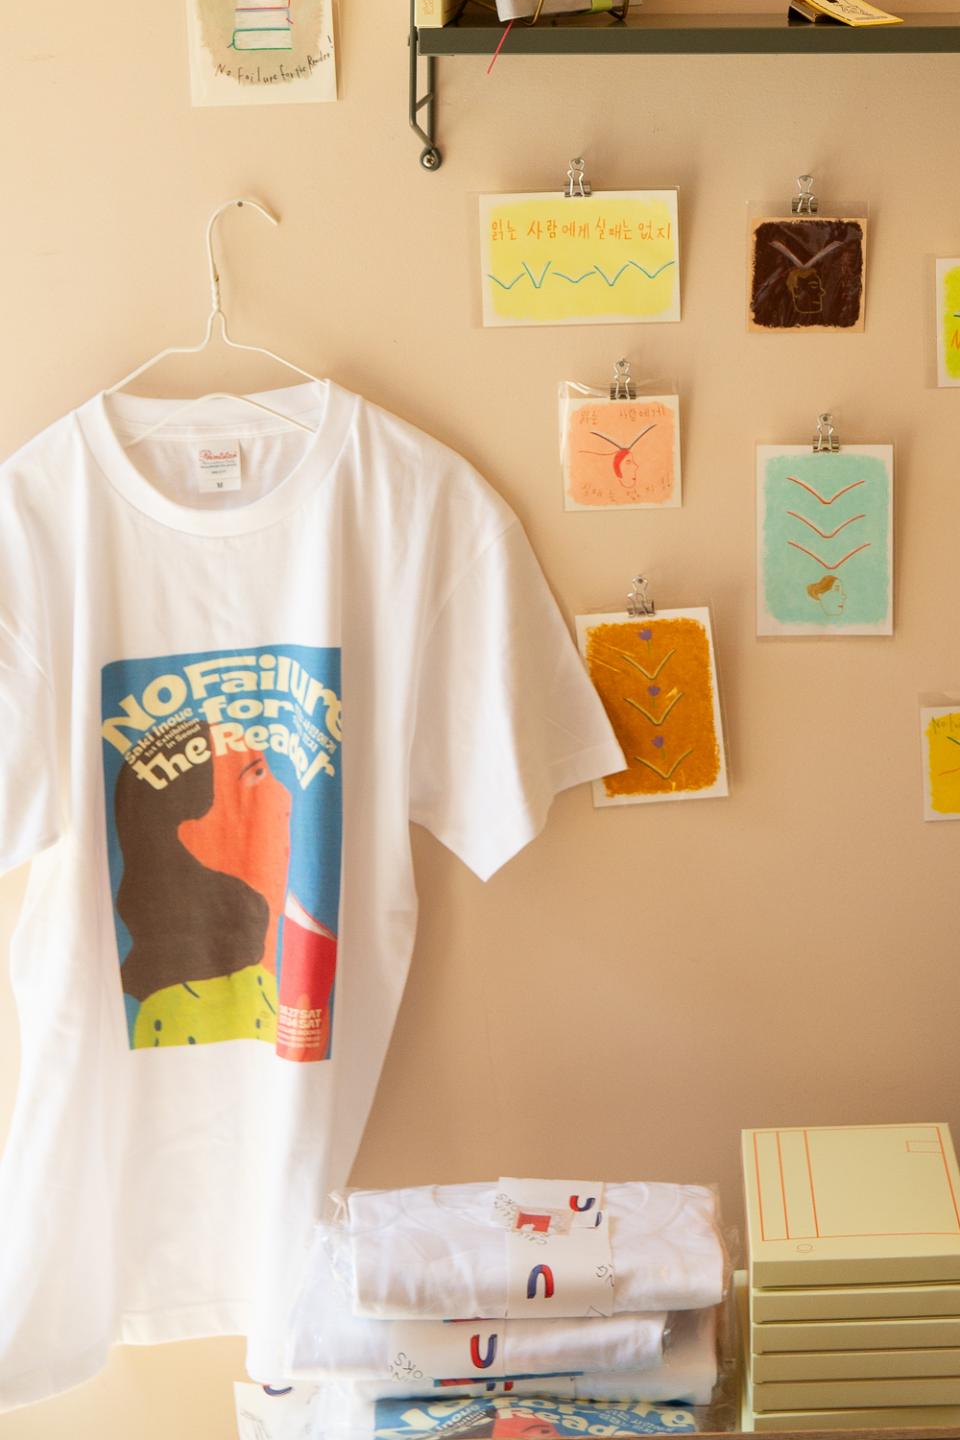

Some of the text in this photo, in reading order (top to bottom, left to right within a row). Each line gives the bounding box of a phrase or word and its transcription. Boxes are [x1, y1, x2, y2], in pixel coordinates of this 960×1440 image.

[492, 218, 517, 240] 읽는
[595, 216, 632, 240] 실패는
[638, 220, 671, 240] 없지
[198, 696, 296, 723] for
[131, 737, 212, 790] the
